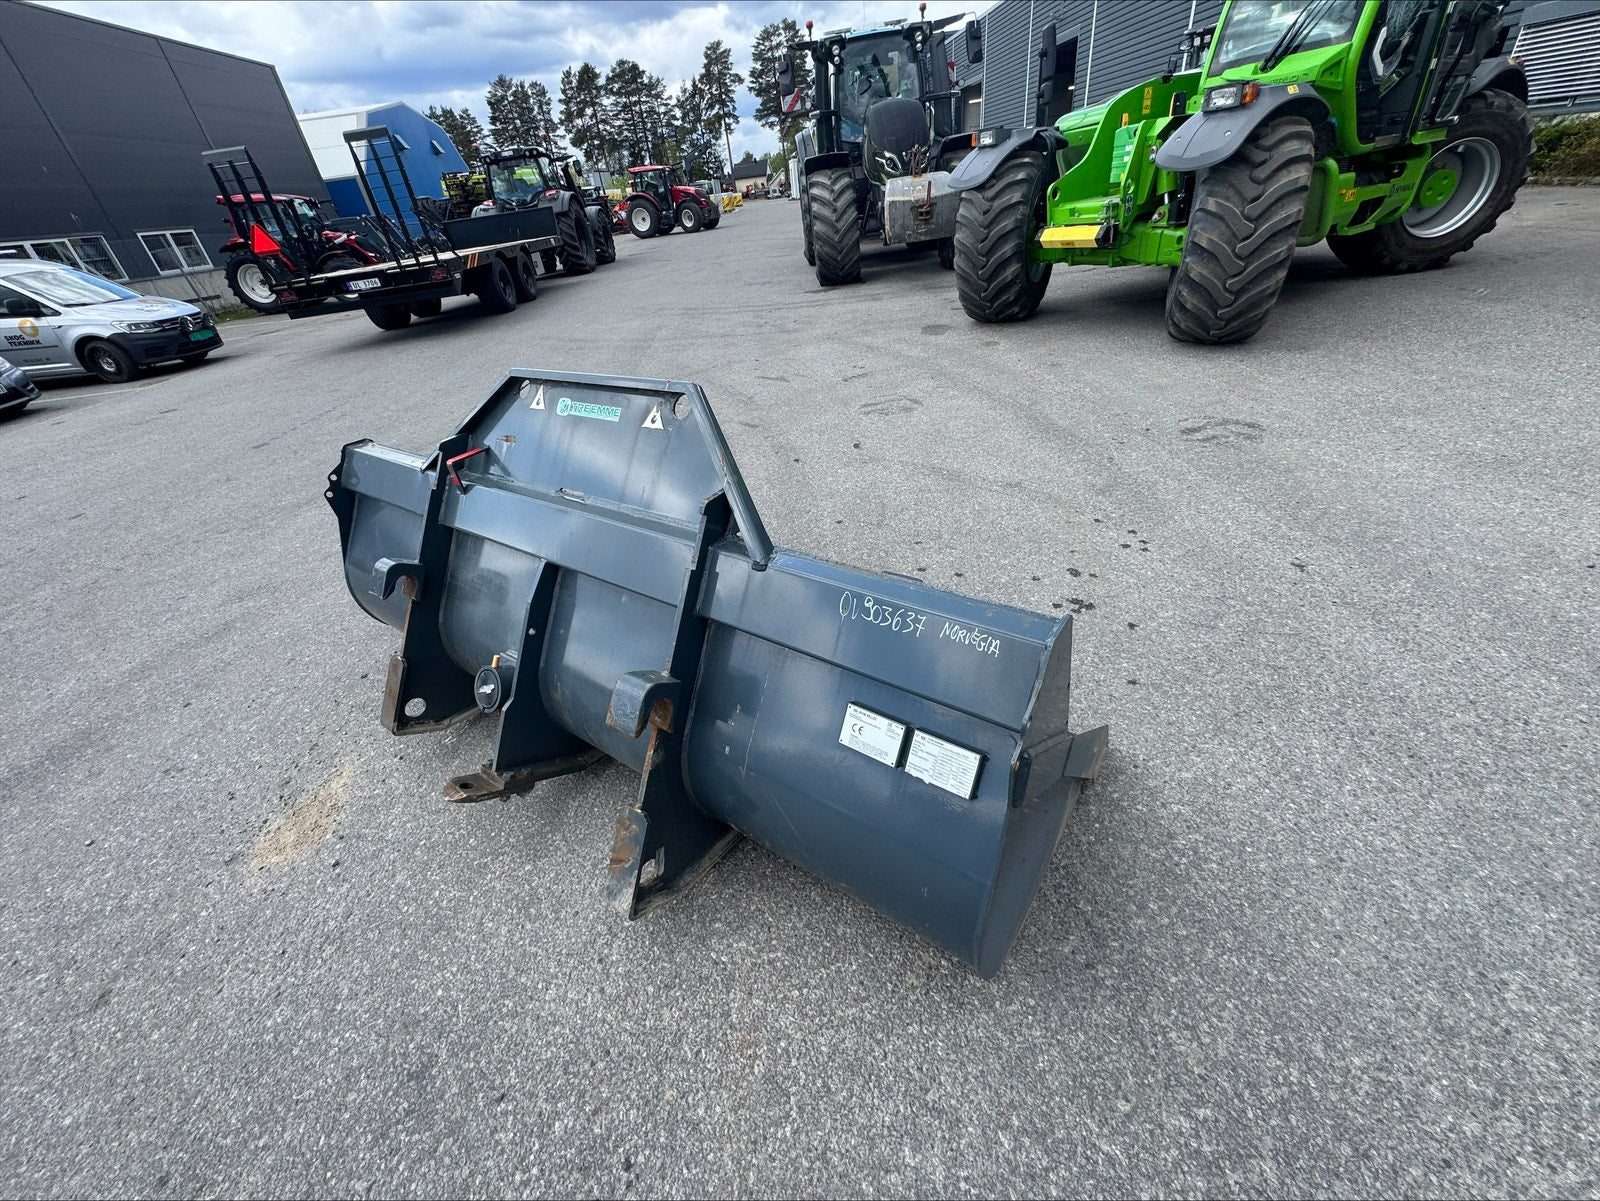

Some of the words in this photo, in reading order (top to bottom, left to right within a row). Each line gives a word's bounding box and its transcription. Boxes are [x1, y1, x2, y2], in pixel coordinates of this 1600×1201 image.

[363, 279, 379, 288] 3706
[7, 339, 42, 347] TEKNIKK
[571, 402, 620, 418] TREEMME
[940, 621, 1001, 657] NORVEGIA
